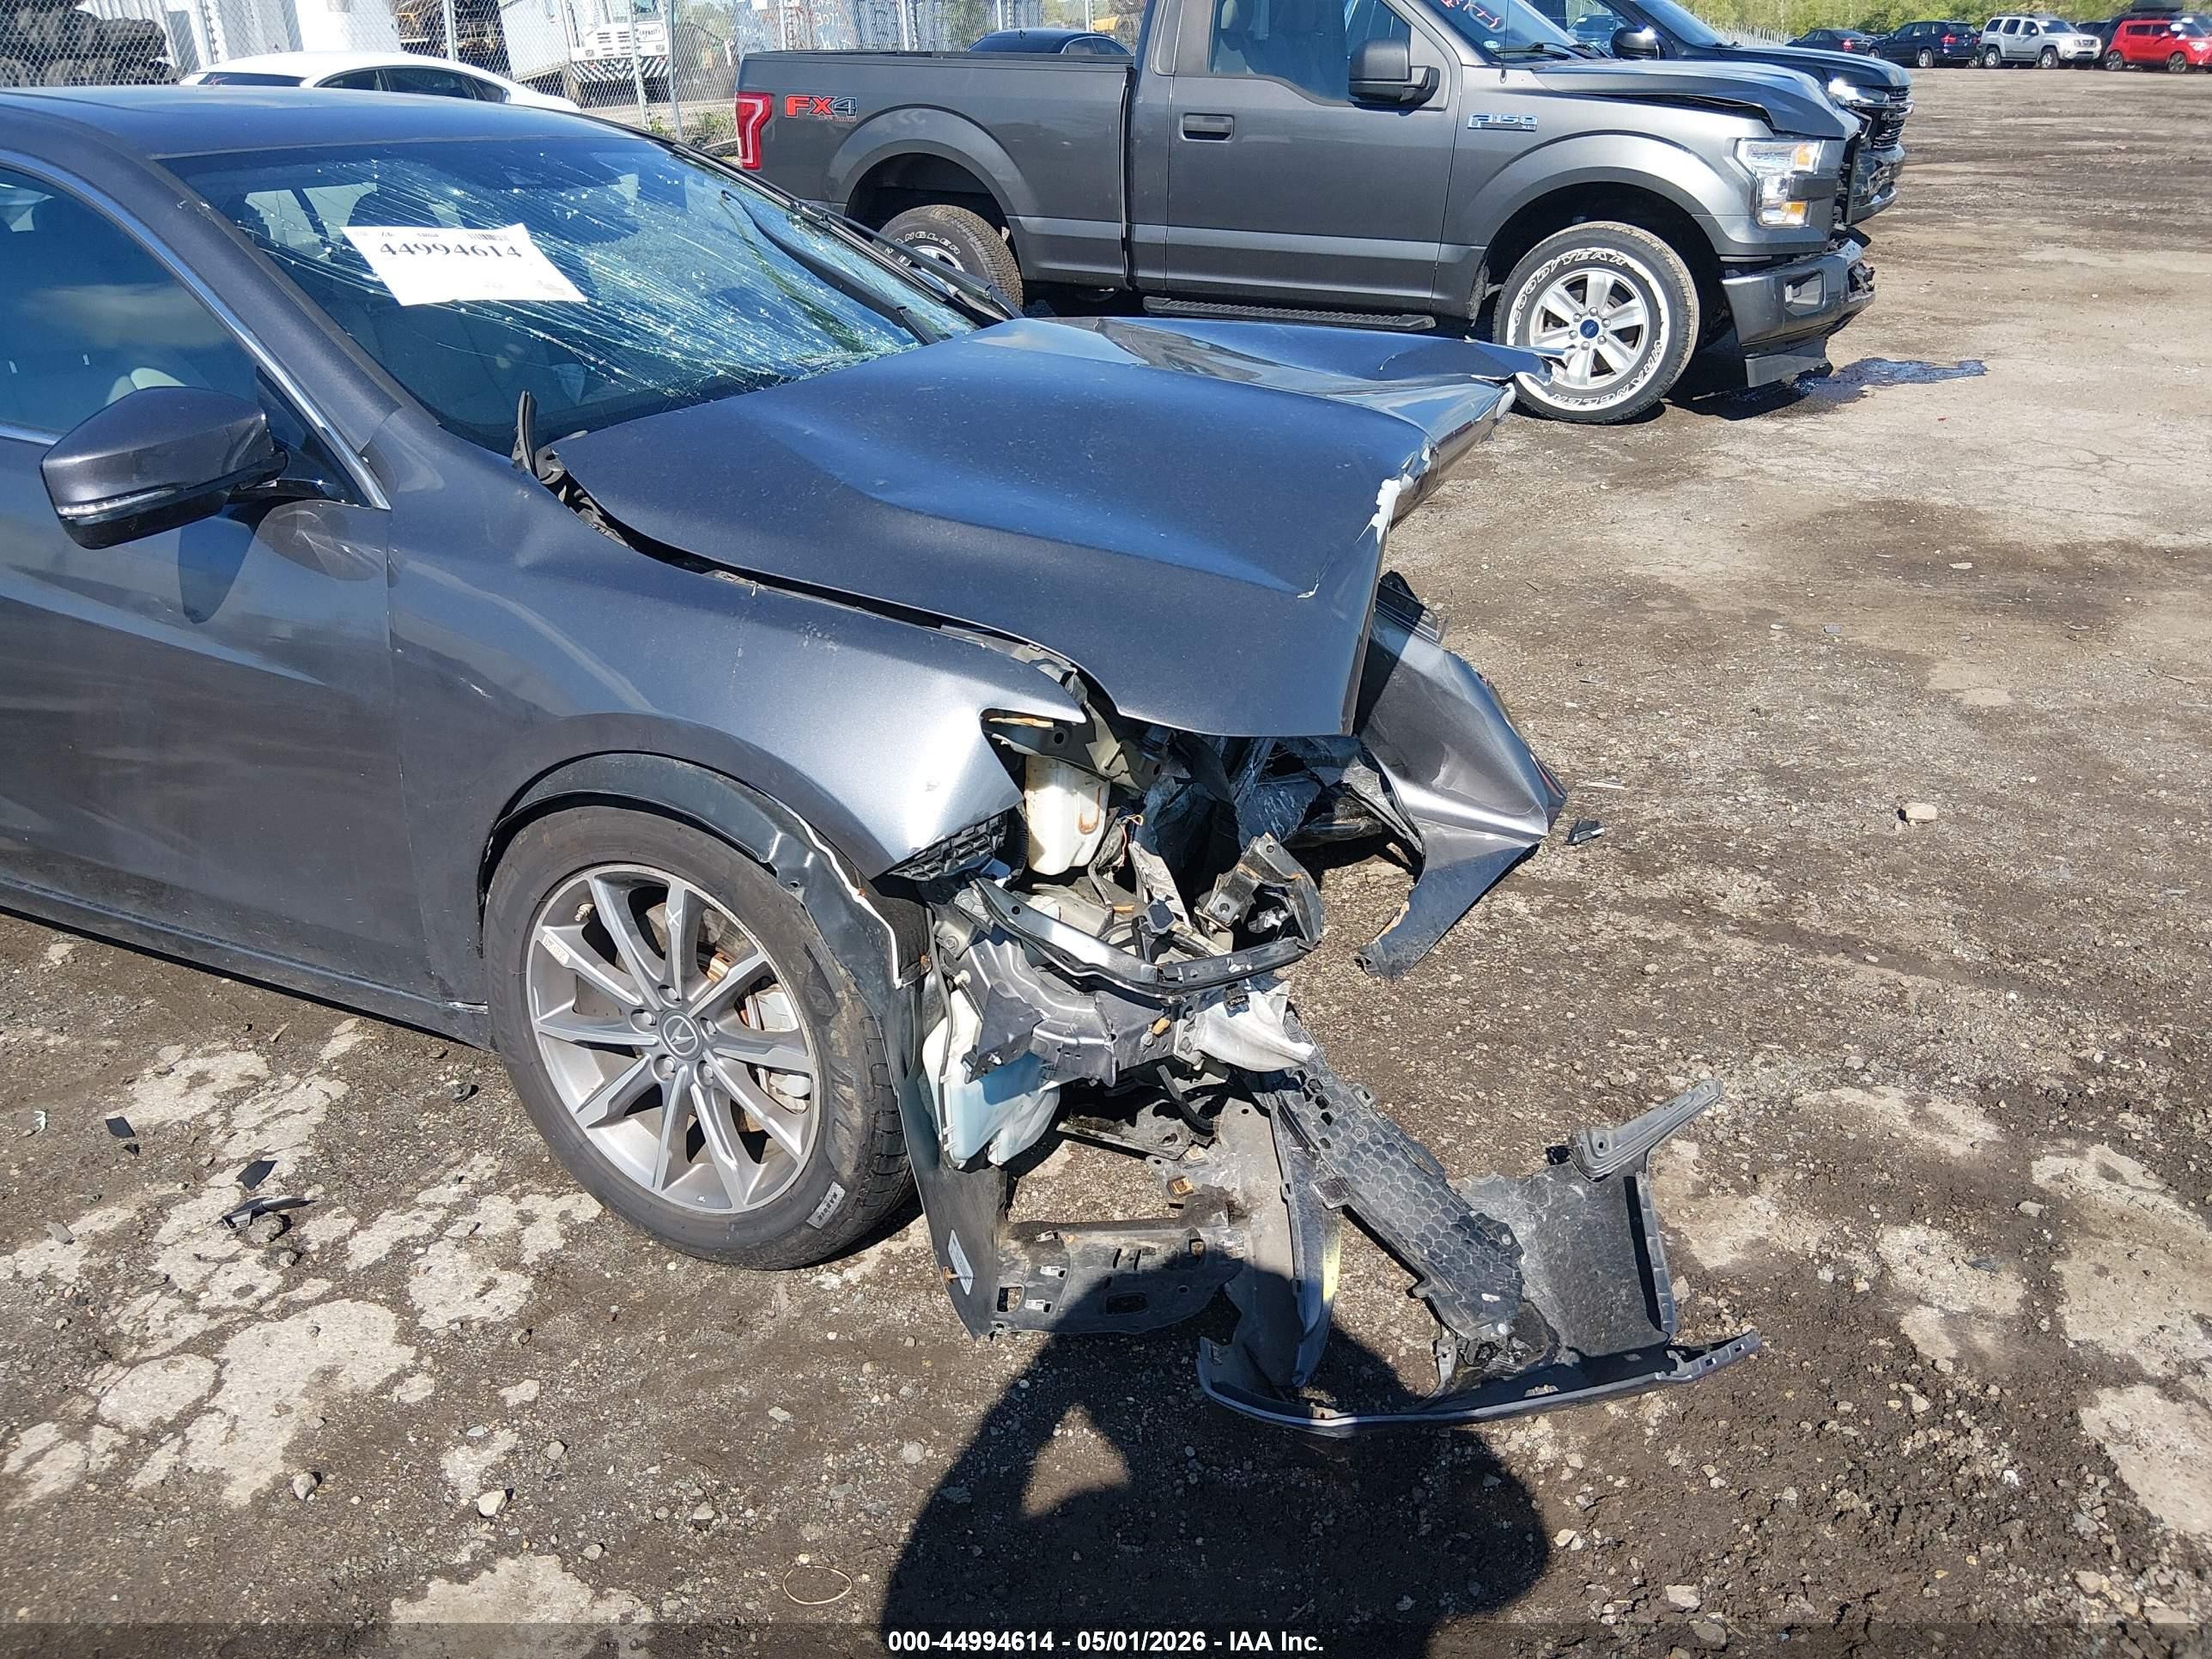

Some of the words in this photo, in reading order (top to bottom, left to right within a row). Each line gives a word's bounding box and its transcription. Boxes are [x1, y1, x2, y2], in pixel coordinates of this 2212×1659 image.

[785, 94, 857, 118] FX4
[380, 243, 522, 258] 44994614
[1512, 251, 1628, 325] GOODYEAR
[1552, 340, 1663, 406] WRANGLER
